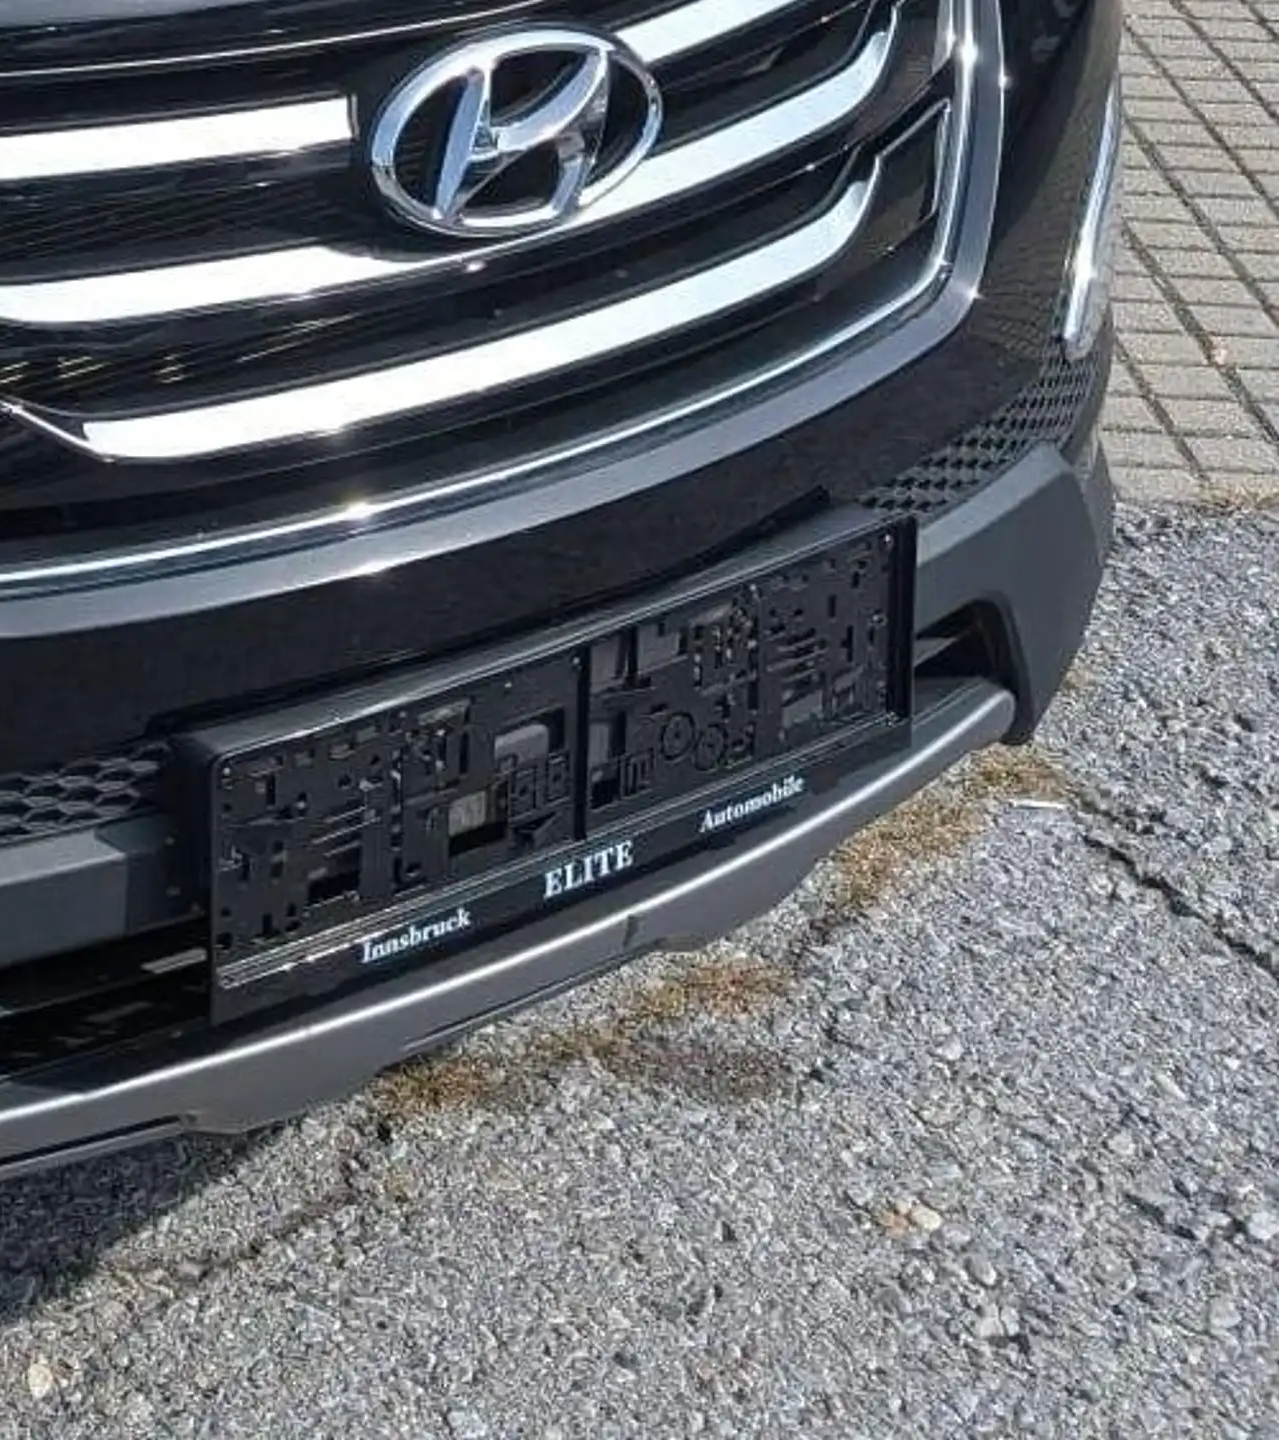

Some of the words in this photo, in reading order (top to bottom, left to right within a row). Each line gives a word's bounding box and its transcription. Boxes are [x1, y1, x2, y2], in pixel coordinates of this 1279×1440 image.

[361, 907, 471, 964] Innsbruck
[542, 839, 634, 901] ELITE
[699, 775, 804, 833] Automobile
